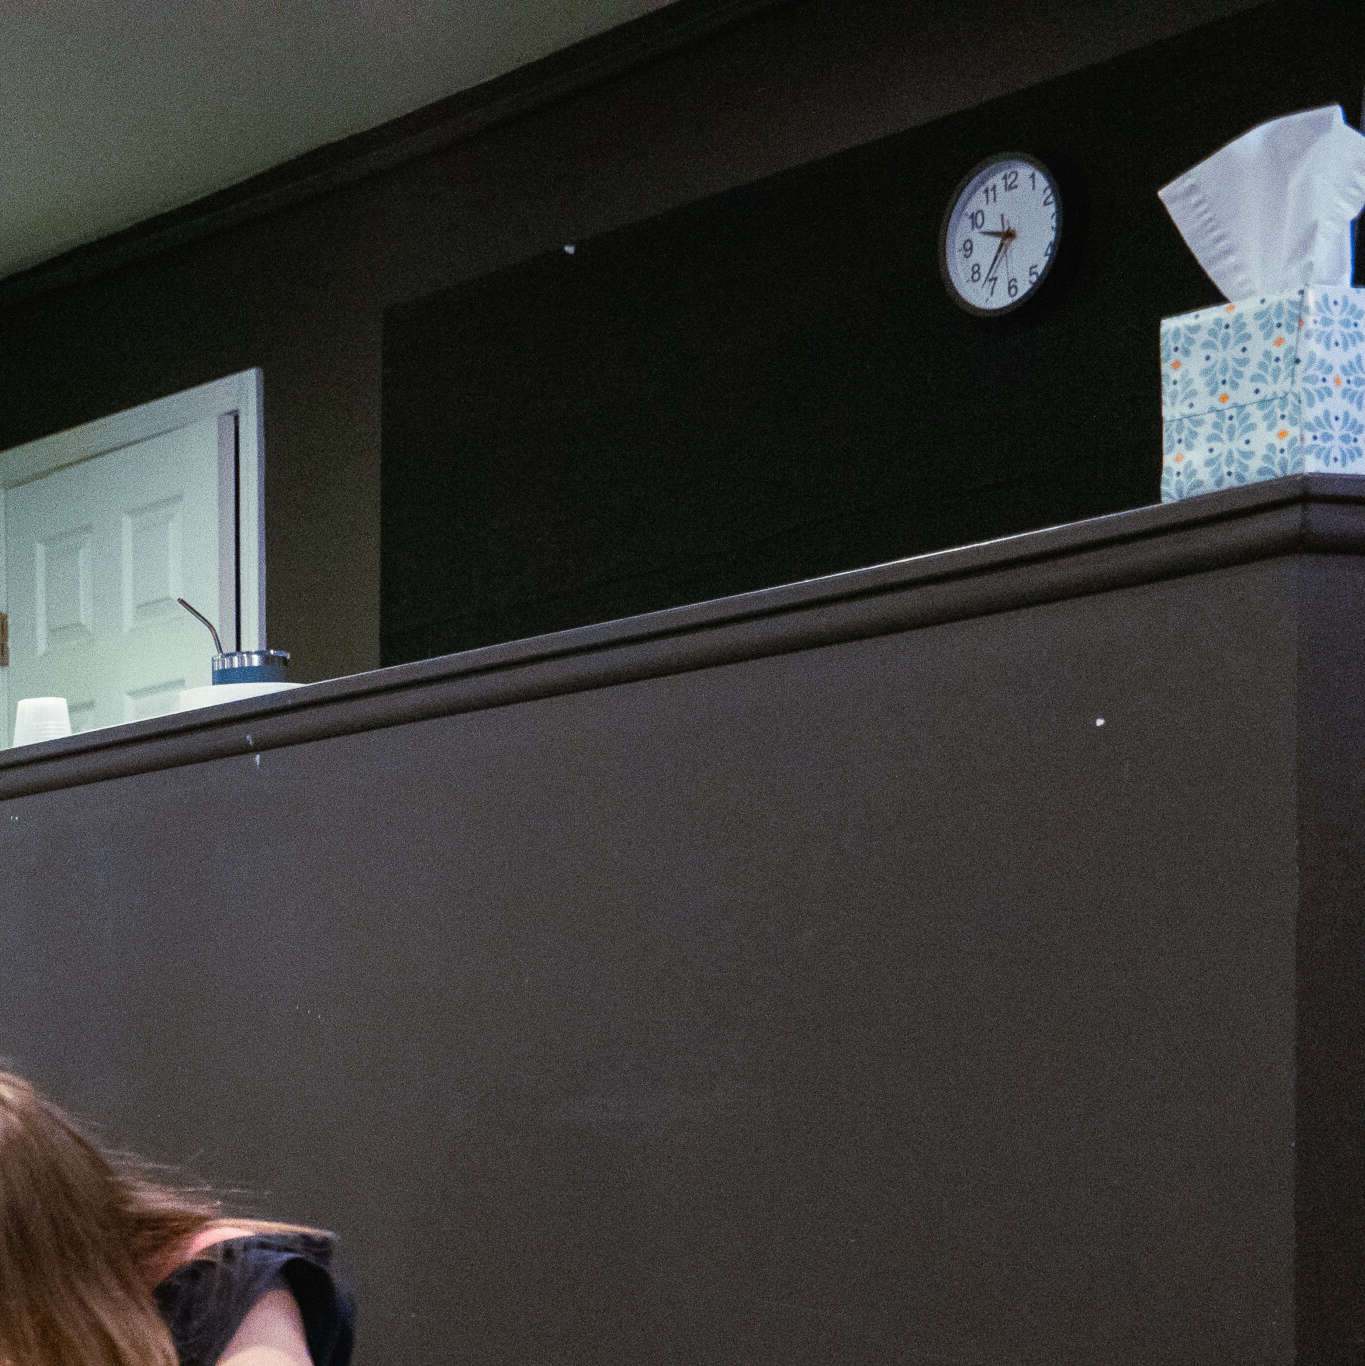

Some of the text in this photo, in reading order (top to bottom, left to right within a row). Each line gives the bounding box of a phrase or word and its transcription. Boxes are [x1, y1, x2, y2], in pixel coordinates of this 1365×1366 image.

[1002, 170, 1018, 192] 12
[1029, 172, 1036, 191] 1
[982, 183, 997, 205] 11
[1042, 186, 1053, 207] 2
[969, 209, 985, 231] 10
[962, 239, 973, 259] 9
[970, 263, 981, 283] 8
[1029, 264, 1039, 285] 5
[988, 276, 998, 297] 7
[1007, 278, 1018, 298] 6
